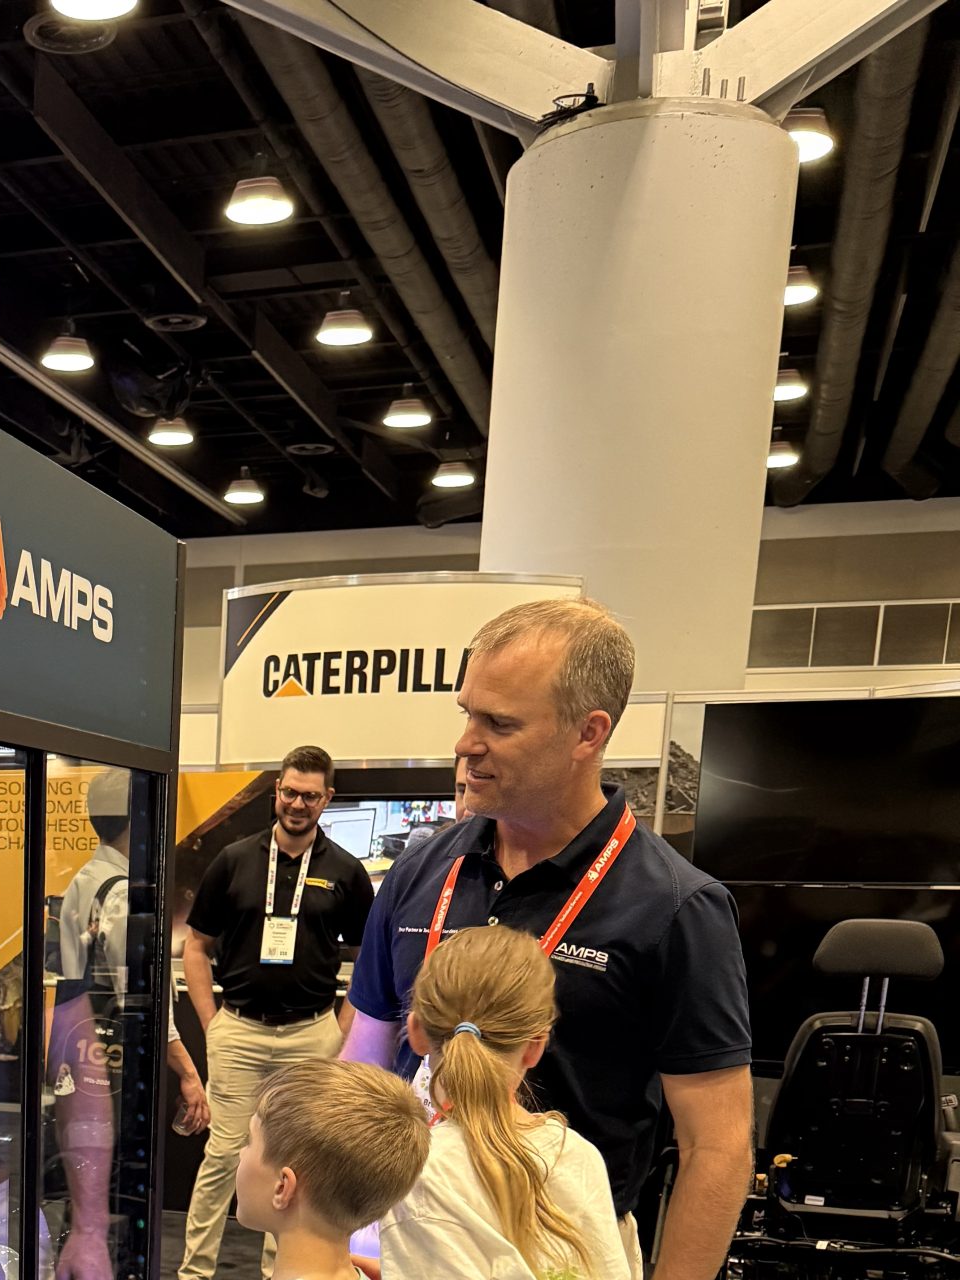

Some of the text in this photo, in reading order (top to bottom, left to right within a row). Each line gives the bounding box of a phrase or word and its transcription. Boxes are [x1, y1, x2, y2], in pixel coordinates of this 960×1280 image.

[10, 549, 114, 643] AMPS
[594, 838, 619, 872] AMPS
[556, 942, 608, 963] AMPS
